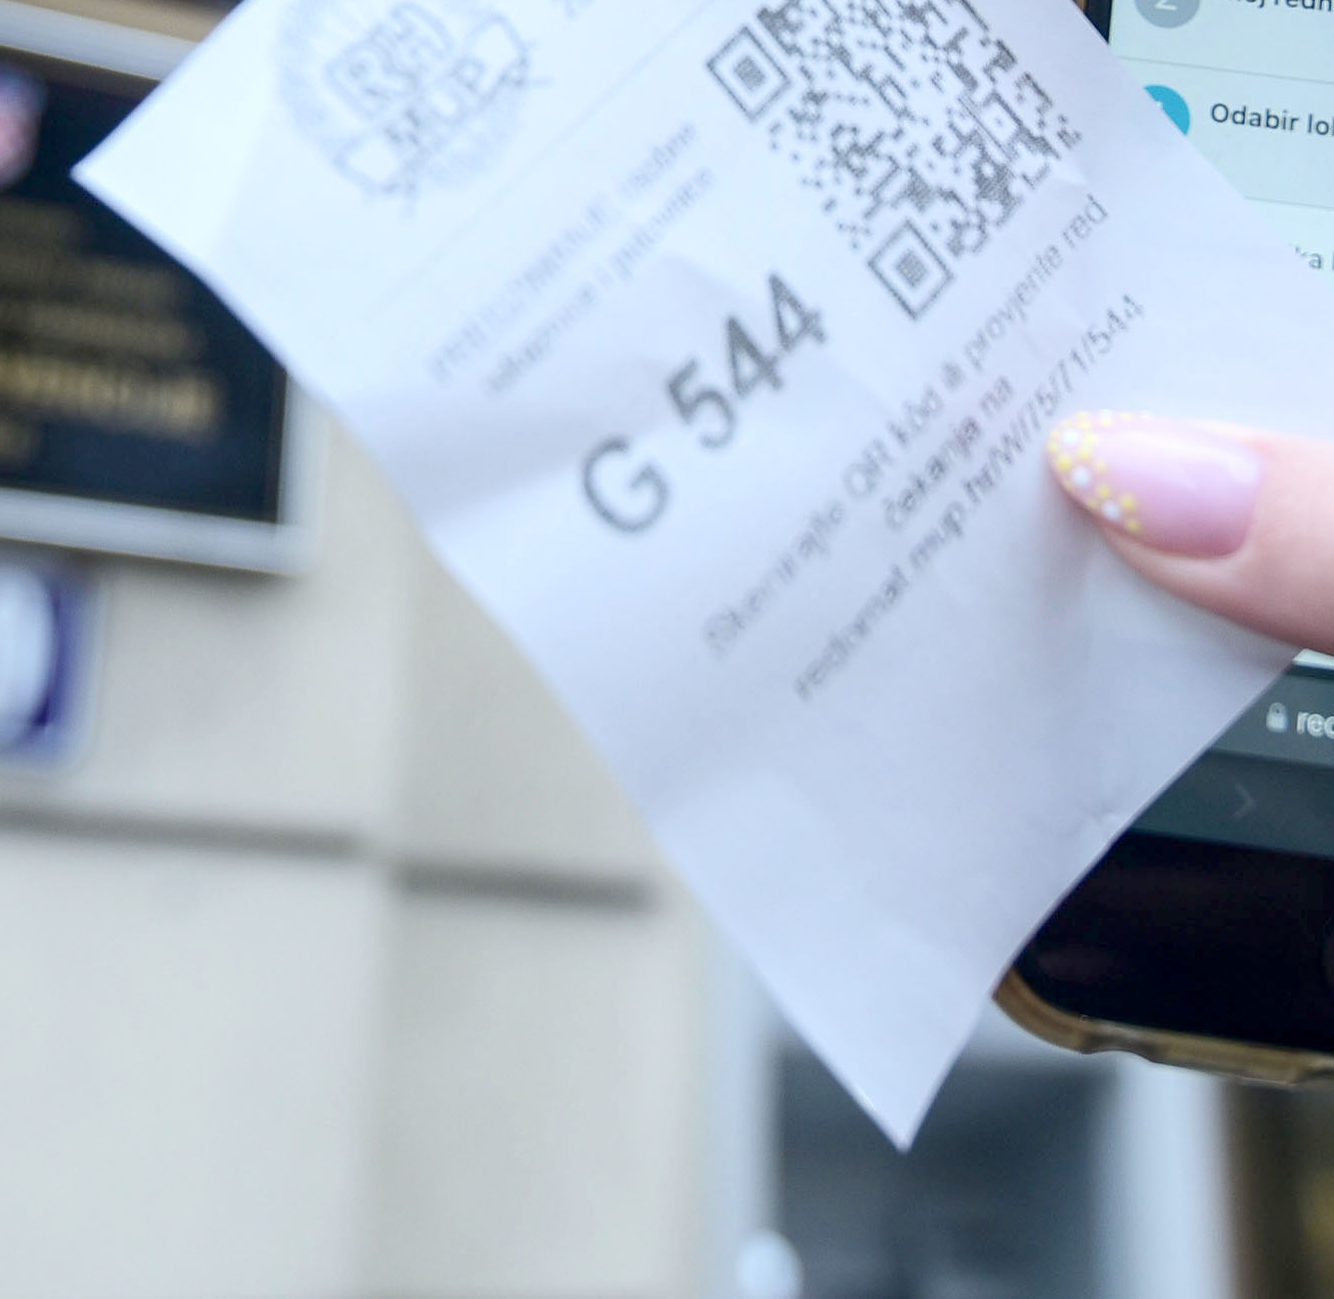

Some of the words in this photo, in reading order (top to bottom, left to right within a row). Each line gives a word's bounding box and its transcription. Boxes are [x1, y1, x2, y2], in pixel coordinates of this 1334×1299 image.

[1210, 102, 1299, 132] Odabir
[581, 435, 670, 534] G
[666, 272, 827, 448] 544
[842, 439, 893, 500] QR
[1062, 192, 1111, 251] red
[982, 375, 1015, 416] na
